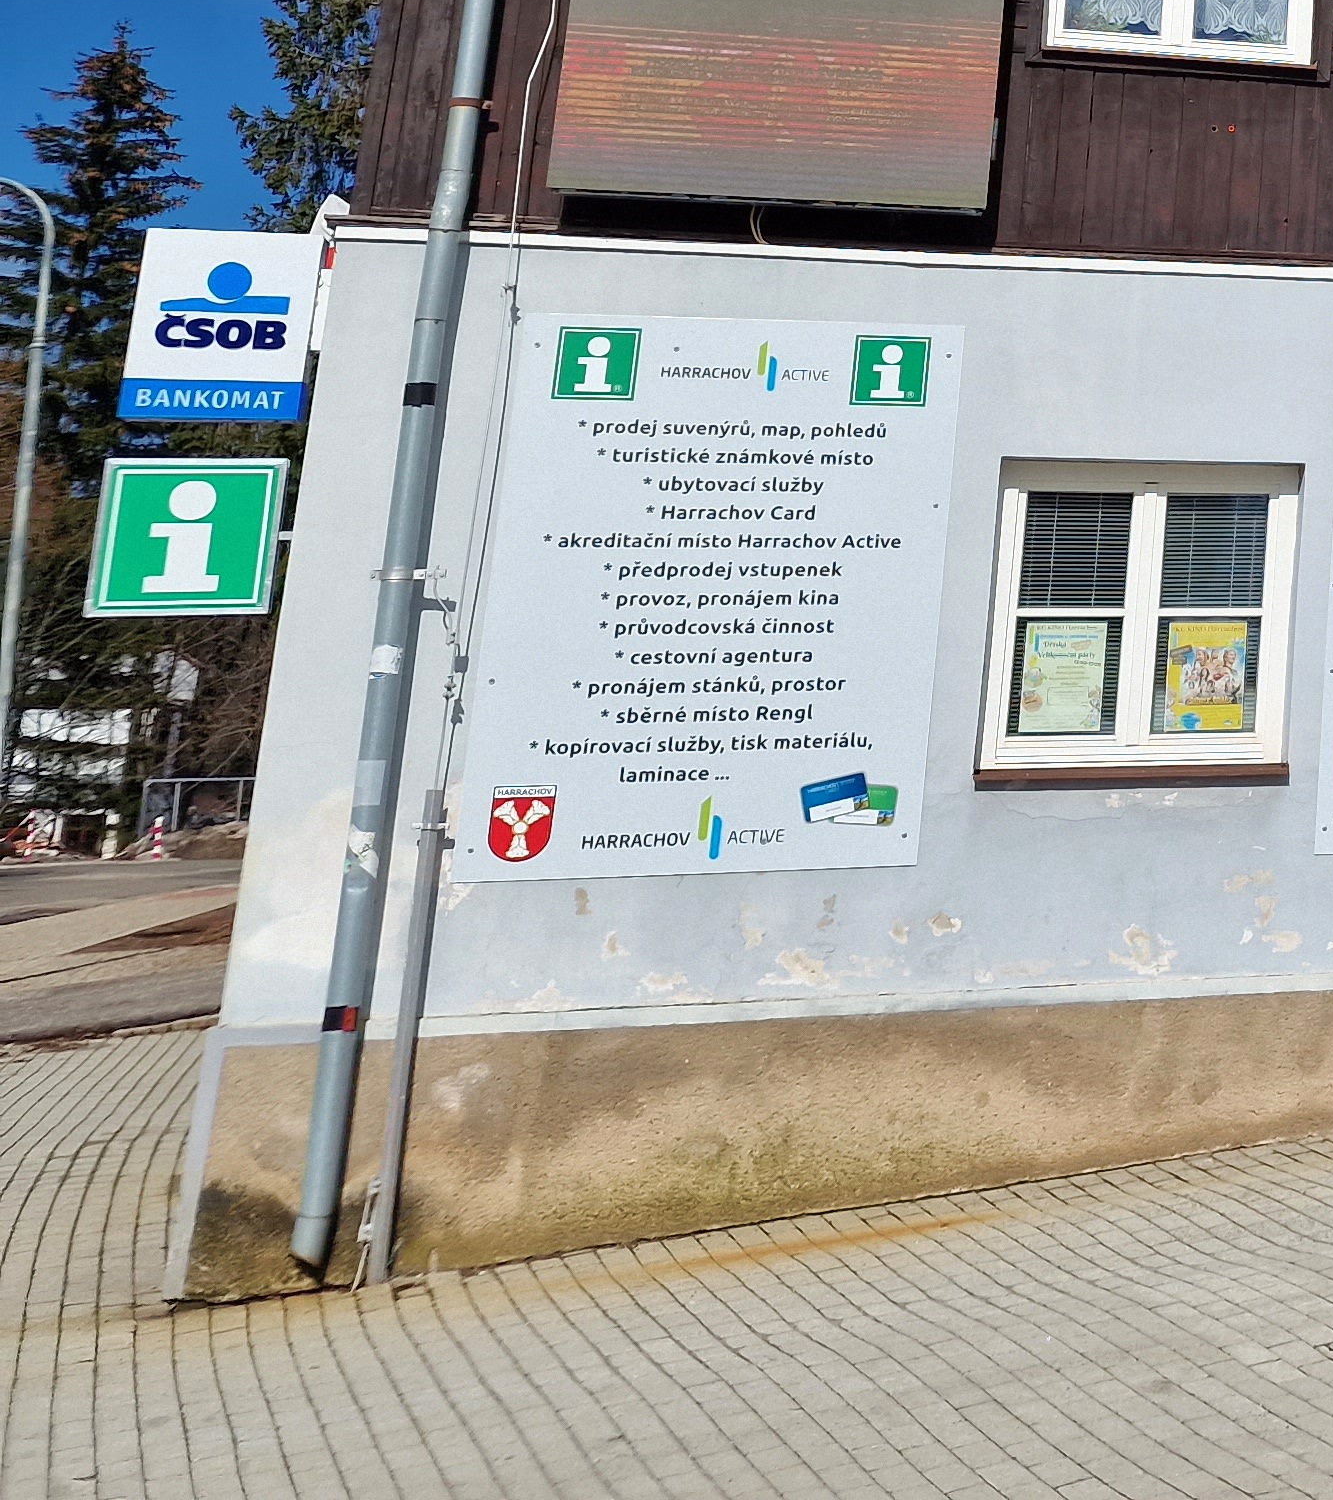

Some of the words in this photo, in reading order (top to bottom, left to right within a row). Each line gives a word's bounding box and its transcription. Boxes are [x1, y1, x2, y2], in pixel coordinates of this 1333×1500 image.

[154, 314, 287, 350] ČSOB
[661, 367, 751, 379] HARRACHOV
[781, 369, 829, 381] ACTIVE
[135, 386, 285, 410] BANKOMAT
[593, 419, 657, 437] prodej
[663, 420, 755, 438] suvenýrů,
[762, 426, 805, 439] map,
[811, 423, 886, 440] pohledů
[613, 448, 709, 463] turistické
[716, 449, 814, 464] známkové
[821, 450, 873, 465] místo
[659, 476, 756, 494] ubytovací
[762, 477, 824, 495] služby
[661, 505, 764, 519] Harrachov
[771, 505, 816, 520] Card
[558, 533, 672, 548] akreditační
[678, 533, 731, 548] místo
[738, 533, 837, 548] Harrachov
[841, 534, 901, 548] Active
[619, 561, 732, 580] předprodej
[739, 561, 842, 580] vstupenek
[616, 595, 690, 609] provoz,
[698, 590, 791, 609] pronájem
[799, 590, 838, 605] kina
[615, 618, 755, 638] průvodcovská
[762, 618, 834, 633] činnost
[631, 648, 717, 664] cestovní
[722, 649, 812, 666] agentura
[588, 678, 685, 698] pronájem
[692, 675, 764, 694] stánků,
[772, 677, 846, 695] prostor
[616, 706, 686, 723] sběrné
[693, 706, 749, 722] místo
[756, 704, 812, 723] Rengl
[545, 737, 652, 758] kopírovací
[657, 736, 724, 754] služby,
[732, 734, 768, 750] tisk
[774, 732, 872, 750] materiálu,
[620, 766, 709, 782] laminace
[582, 832, 690, 849] HARRACHOV
[727, 829, 785, 845] ACTIVE
